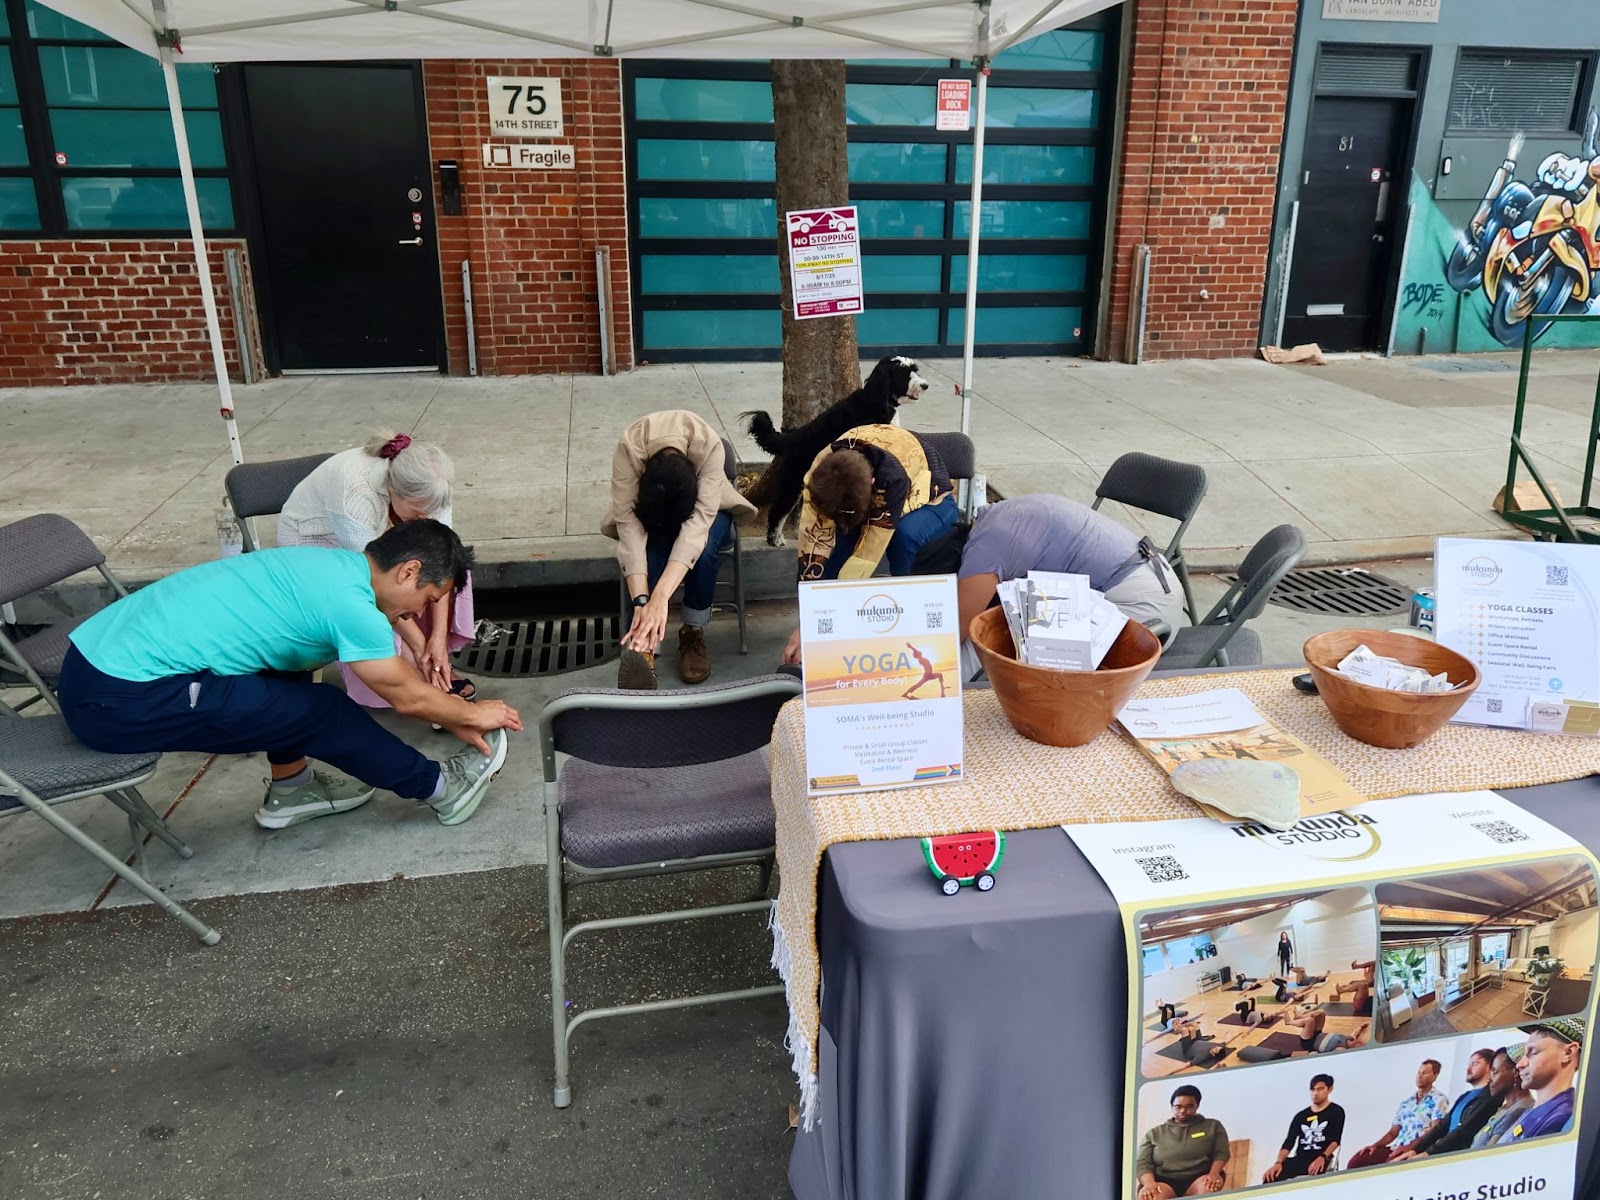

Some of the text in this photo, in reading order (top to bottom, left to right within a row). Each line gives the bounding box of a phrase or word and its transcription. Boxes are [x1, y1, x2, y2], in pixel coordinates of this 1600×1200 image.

[502, 85, 547, 115] 75
[941, 90, 967, 100] LOADING
[945, 100, 962, 109] DOCK
[495, 120, 559, 129] 14TH STREET
[1338, 136, 1354, 151] 81
[519, 149, 571, 167] Fragile
[794, 233, 854, 246] NO STOPPING
[1461, 564, 1503, 574] mukunda
[1471, 571, 1495, 579] STUDIO
[857, 604, 904, 617] mukunda
[1487, 603, 1554, 615] YOGA CLASSES
[867, 615, 895, 623] STUDIO
[842, 652, 911, 674] YOGA
[836, 675, 907, 689] for Every Body!
[836, 709, 935, 724] SOMA's Well-being Studio
[871, 741, 887, 749] Small
[887, 740, 907, 748] Group
[907, 738, 929, 746] Classes
[854, 748, 886, 757] Meditation
[893, 747, 918, 755] Wellness
[896, 755, 914, 763] Space
[1448, 809, 1495, 819] Website
[1277, 828, 1361, 845] STUDIO
[1112, 843, 1176, 854] Instagram
[1476, 1175, 1547, 1200] Studio
